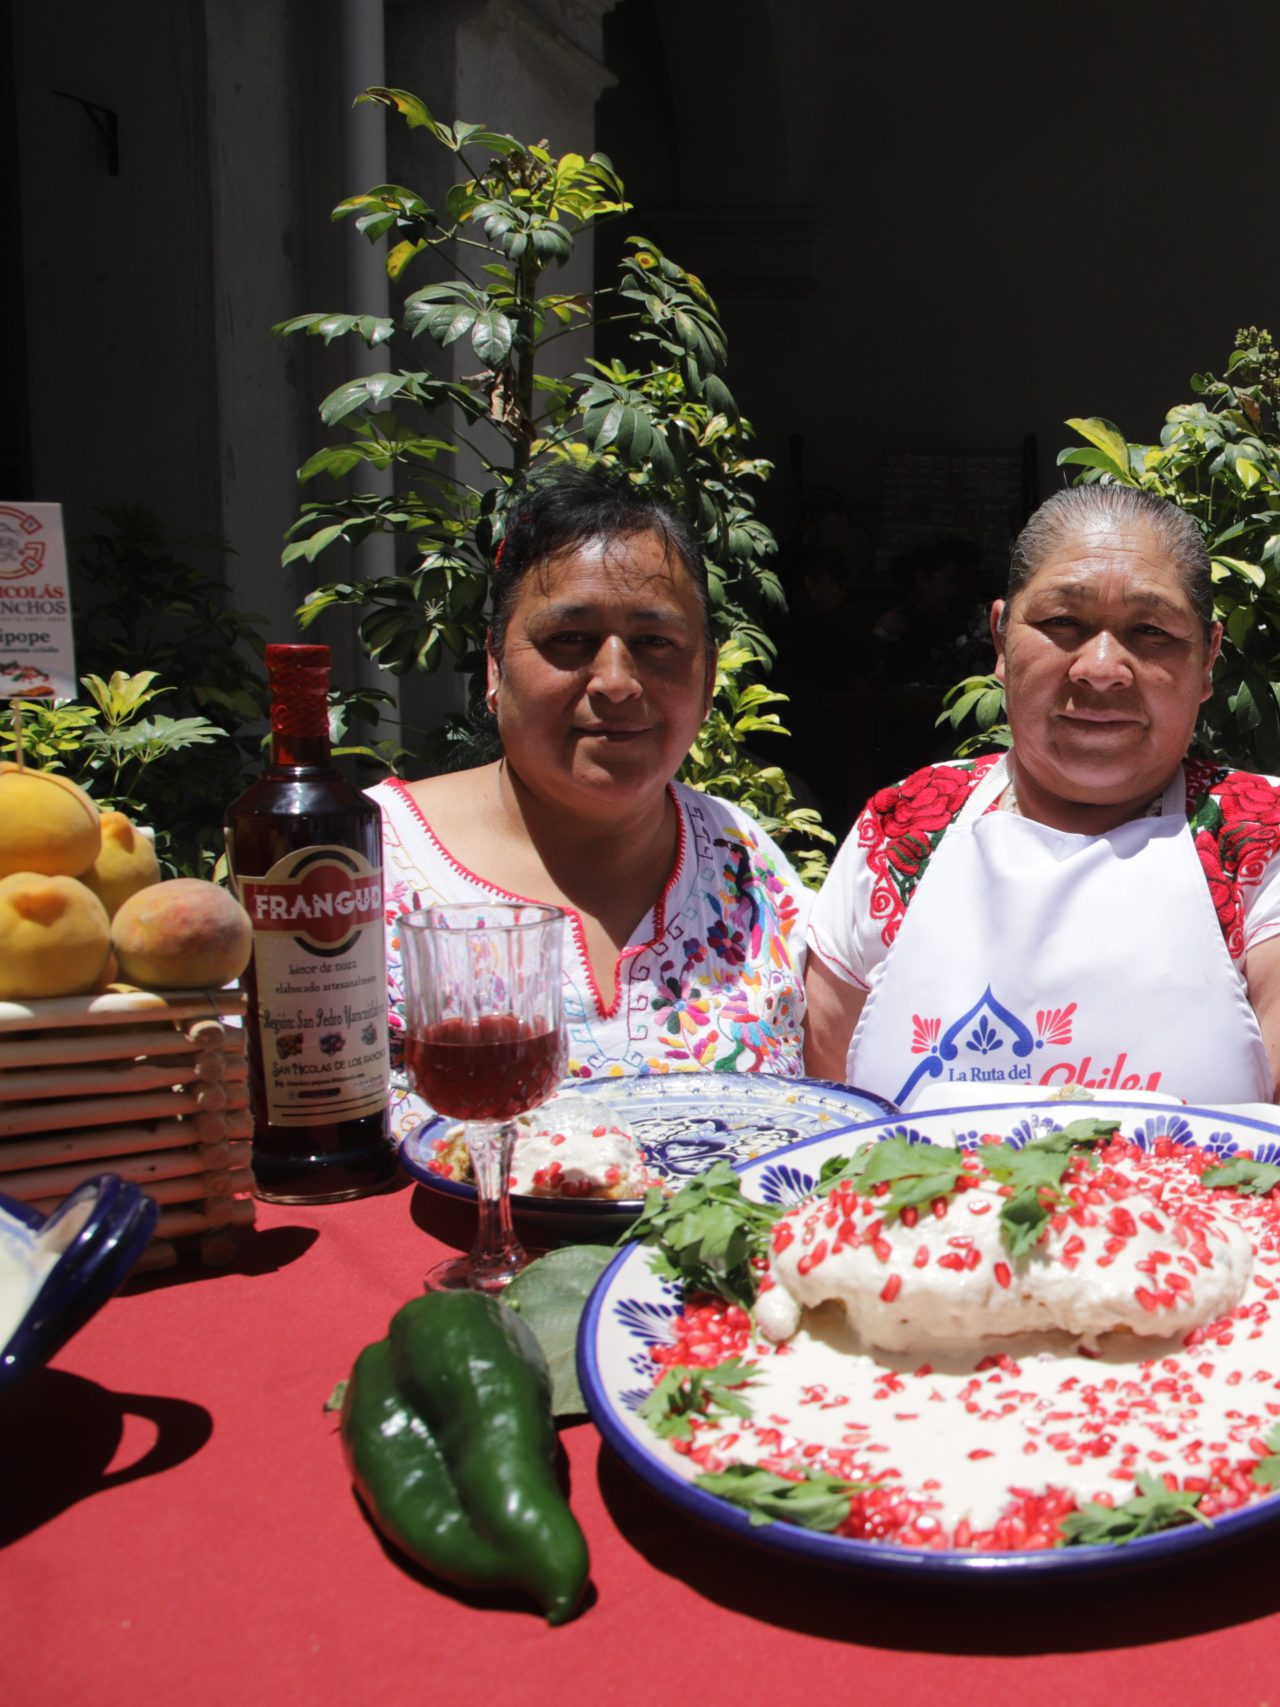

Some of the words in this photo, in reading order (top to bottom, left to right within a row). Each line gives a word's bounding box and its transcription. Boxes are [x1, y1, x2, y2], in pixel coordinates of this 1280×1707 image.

[949, 1068, 967, 1082] La
[971, 1067, 1005, 1082] Ruta
[1008, 1064, 1032, 1080] del
